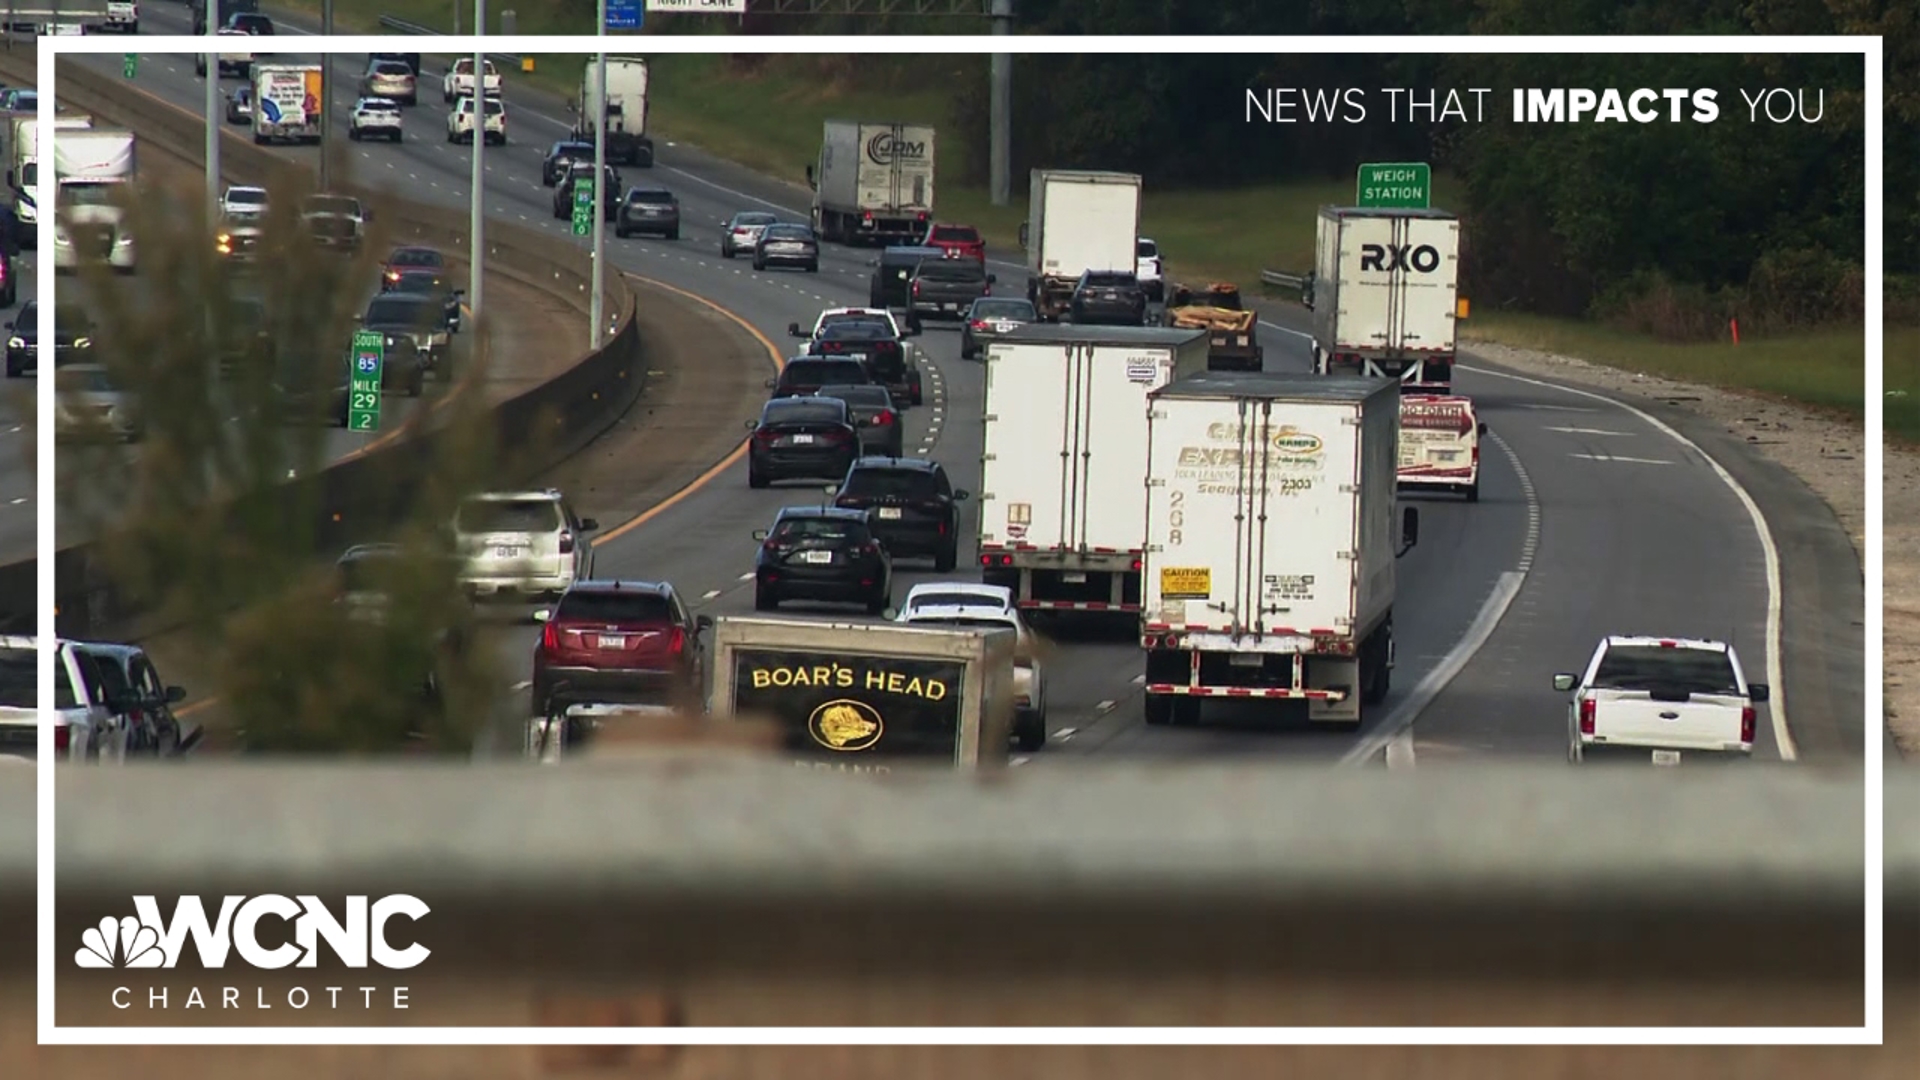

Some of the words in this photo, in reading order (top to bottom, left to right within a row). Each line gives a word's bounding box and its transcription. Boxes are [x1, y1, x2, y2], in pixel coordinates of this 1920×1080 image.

[1372, 170, 1416, 182] WEIGH
[1364, 187, 1422, 199] STATION
[1361, 244, 1440, 273] RXO
[354, 334, 382, 347] SOUTH
[358, 357, 376, 370] 85
[353, 381, 379, 392] MILE
[353, 393, 376, 408] 29
[1163, 568, 1208, 577] CAUTION
[753, 662, 854, 688] BOAR'S
[866, 670, 946, 700] HEAD
